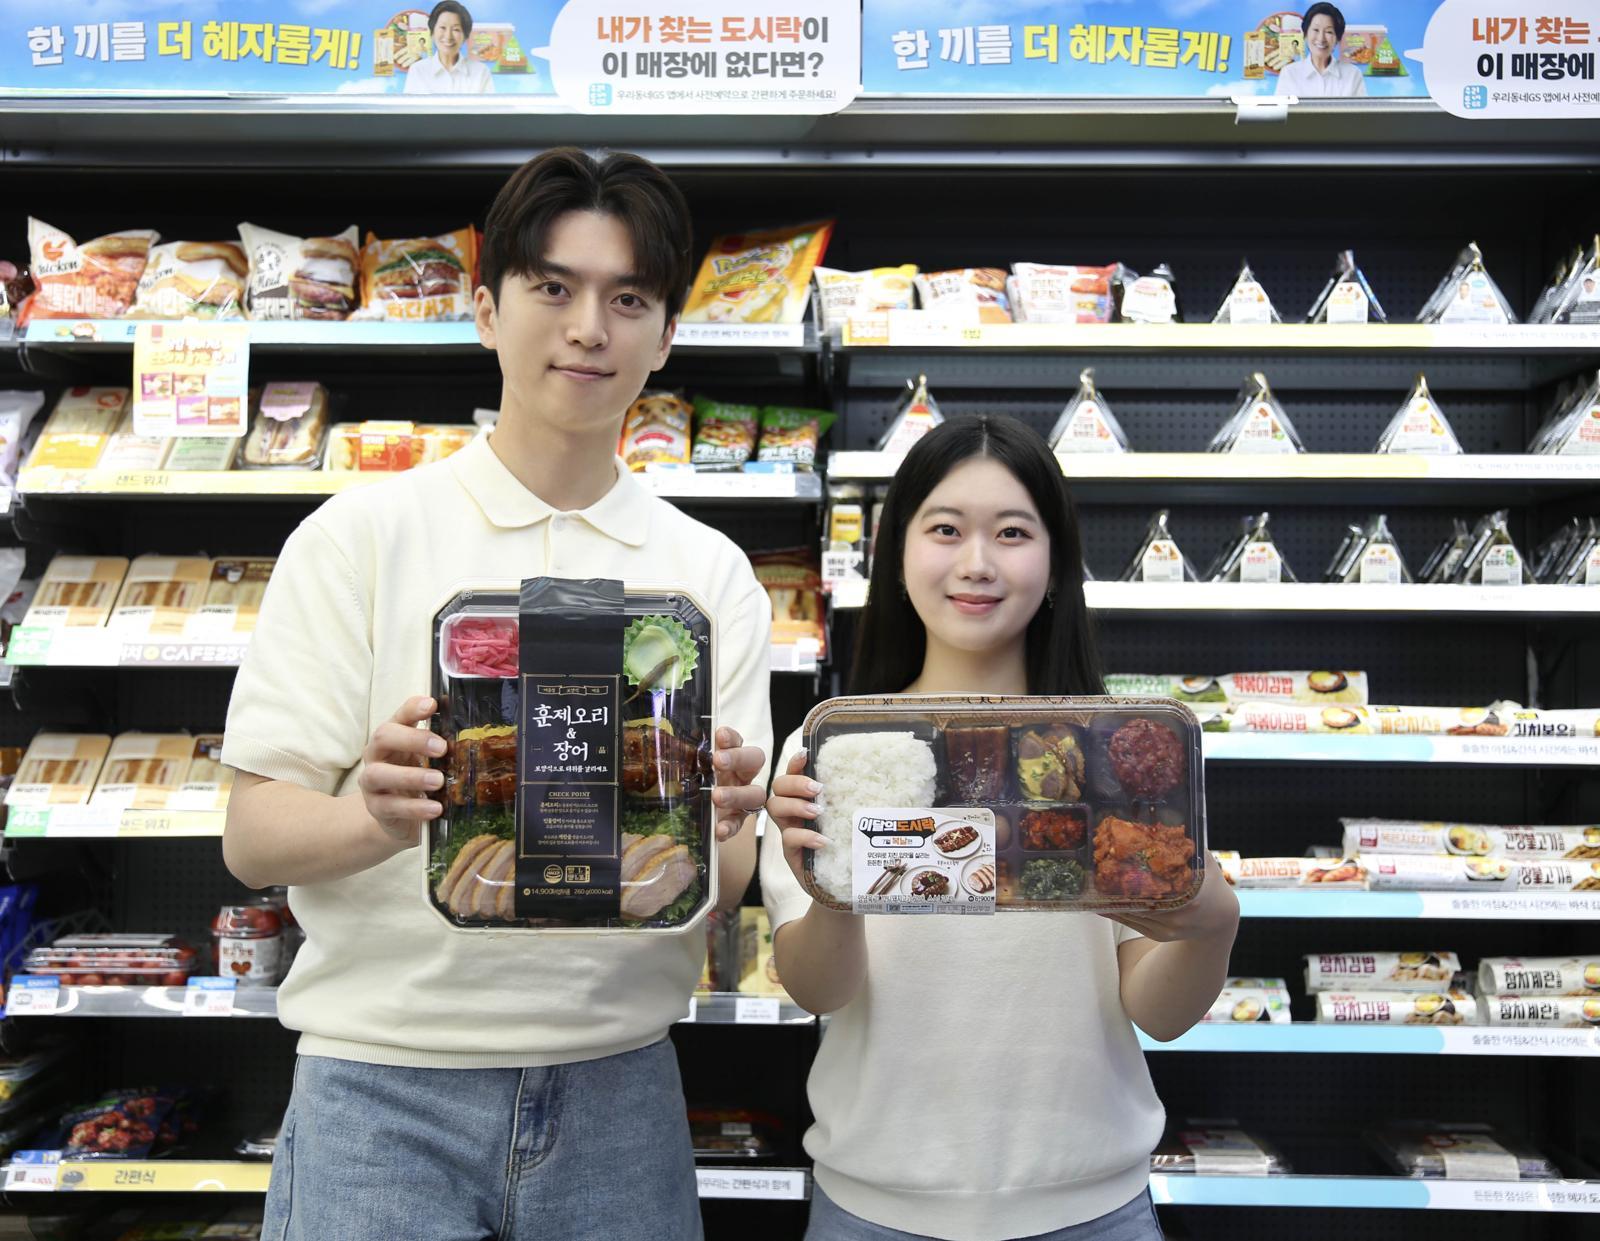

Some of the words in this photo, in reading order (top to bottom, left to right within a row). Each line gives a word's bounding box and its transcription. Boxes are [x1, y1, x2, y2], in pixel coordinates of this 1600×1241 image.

[597, 16, 652, 43] 내가
[658, 16, 712, 43] 찾는
[719, 16, 829, 43] 도시락이
[1472, 17, 1529, 44] 내가
[1535, 17, 1591, 44] 찾는
[27, 25, 65, 67] 한
[74, 21, 147, 62] 끼를
[157, 21, 193, 60] 더
[202, 20, 363, 71] 혜자롭게!
[892, 30, 930, 70] 한
[938, 25, 1013, 65] 끼를
[1023, 25, 1059, 63] 더
[1069, 24, 1232, 73] 혜자롭게!
[602, 51, 628, 78] 이
[635, 51, 717, 78] 매장에
[725, 51, 824, 78] 없다면?
[1477, 53, 1504, 80] 이
[1511, 53, 1595, 80] 매장에
[1492, 92, 1541, 103] 우리동네GS
[1542, 92, 1570, 103] 앱에서
[161, 645, 248, 662] CAFE25
[533, 704, 608, 727] 훈제오리
[566, 728, 577, 739] &
[553, 741, 588, 761] 장어
[534, 765, 564, 773] 보양식으로
[566, 765, 584, 773] 더위를
[585, 765, 608, 773] 날리세요
[1319, 955, 1377, 973] 참치김밥
[1505, 971, 1556, 989] 참치계란
[1333, 1001, 1391, 1021] 참치김밥
[1500, 1003, 1553, 1020] 참치계란
[114, 1170, 156, 1184] 간편식
[732, 1178, 770, 1191] 간편식과
